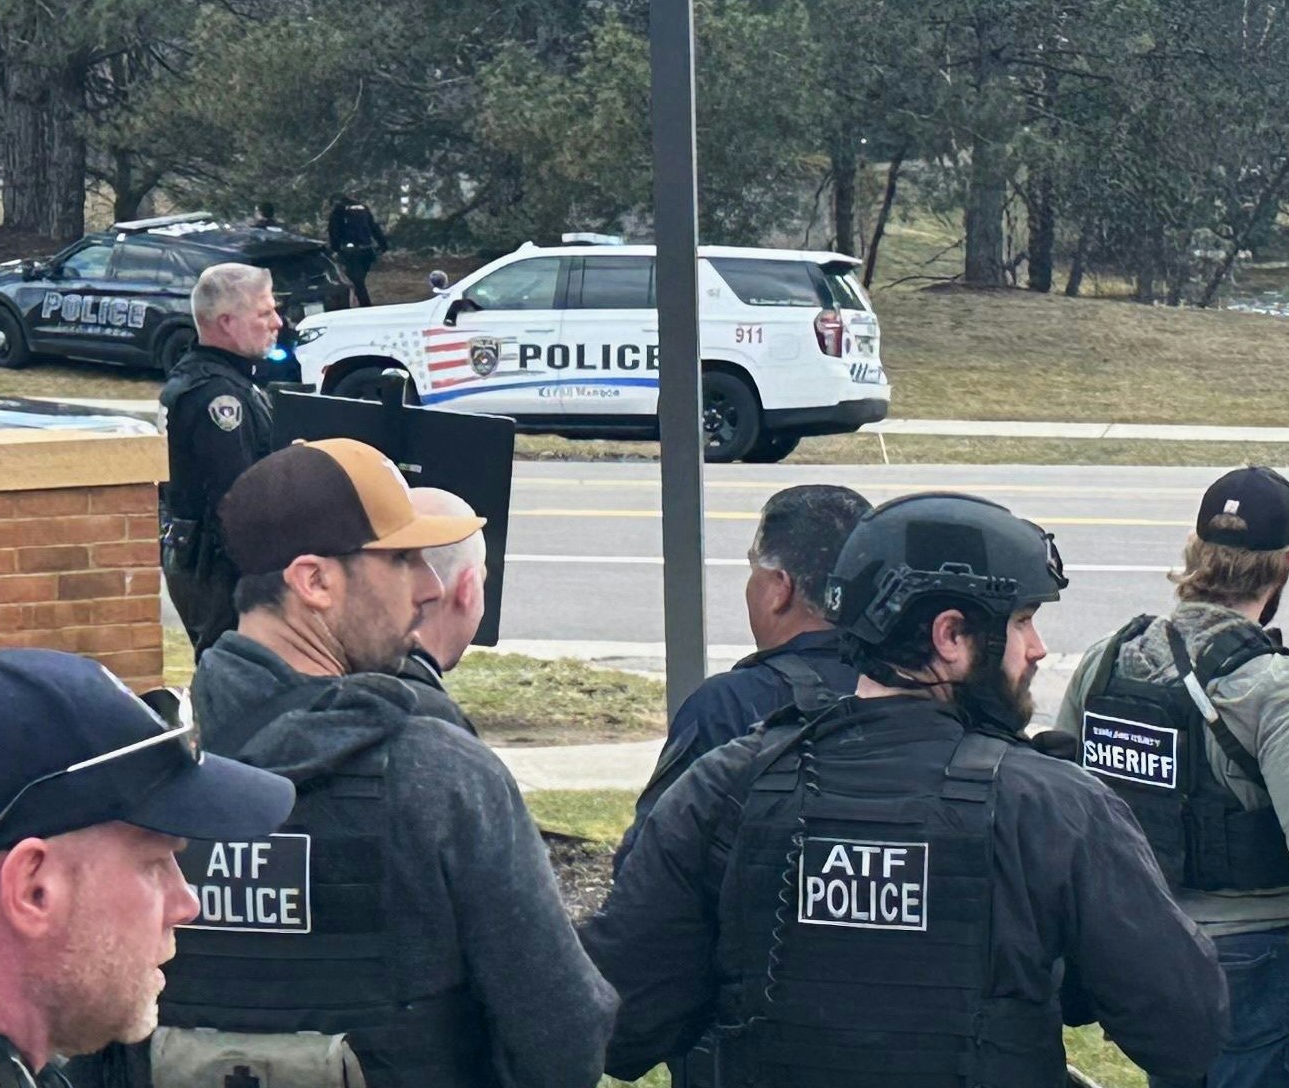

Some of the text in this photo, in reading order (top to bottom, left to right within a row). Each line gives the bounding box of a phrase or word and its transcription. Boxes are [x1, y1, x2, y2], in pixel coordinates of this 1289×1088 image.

[41, 291, 147, 328] POLICE
[735, 327, 763, 344] 911
[1085, 740, 1173, 778] SHERIFF
[206, 842, 271, 879] ATF
[822, 844, 908, 878] ATF
[189, 884, 303, 925] OLICE
[806, 876, 921, 923] POLICE
